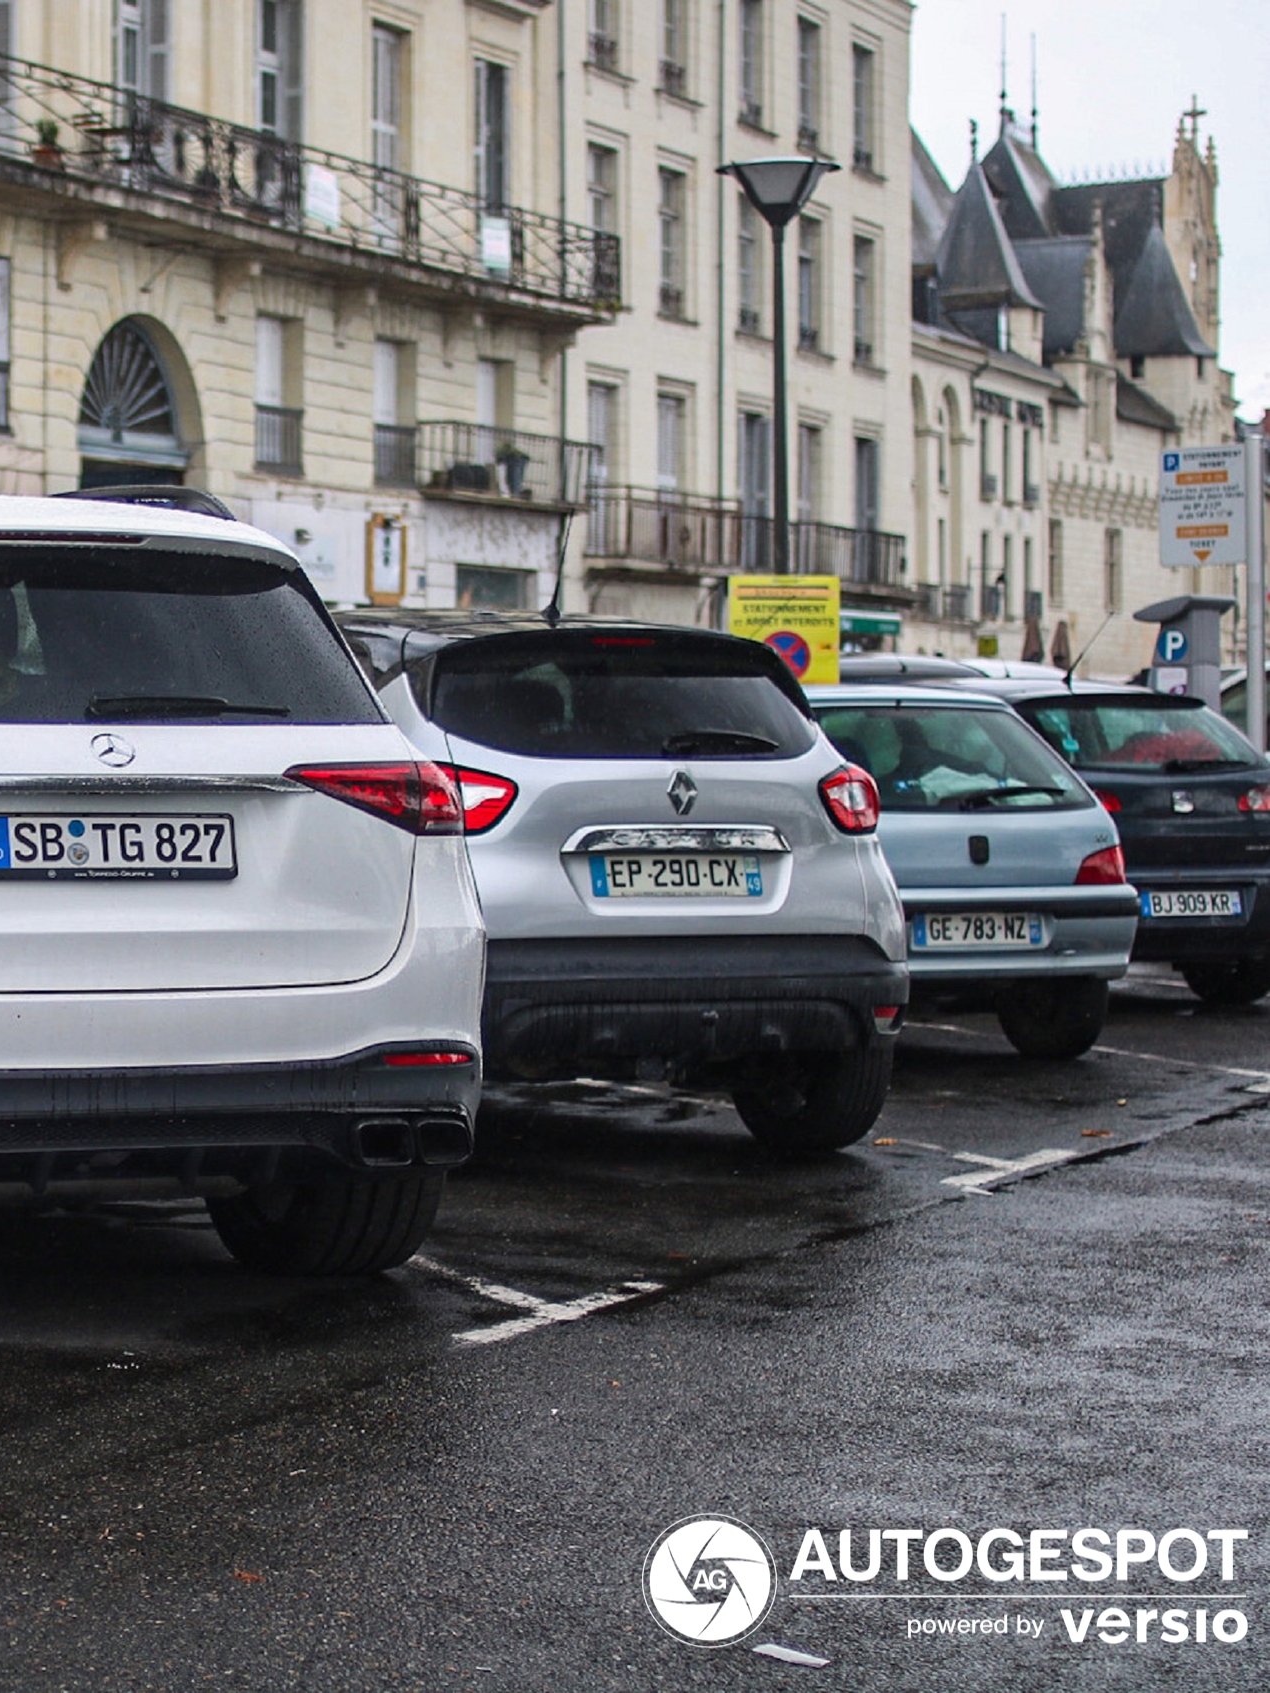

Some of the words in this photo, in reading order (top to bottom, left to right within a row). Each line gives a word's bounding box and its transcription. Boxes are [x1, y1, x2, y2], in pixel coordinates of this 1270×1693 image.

[743, 604, 827, 614] STATIONNEMENT
[782, 617, 835, 627] INTERDITS
[14, 823, 65, 863] SB
[92, 823, 145, 863] TG
[155, 823, 226, 863] 827
[747, 879, 761, 892] 49
